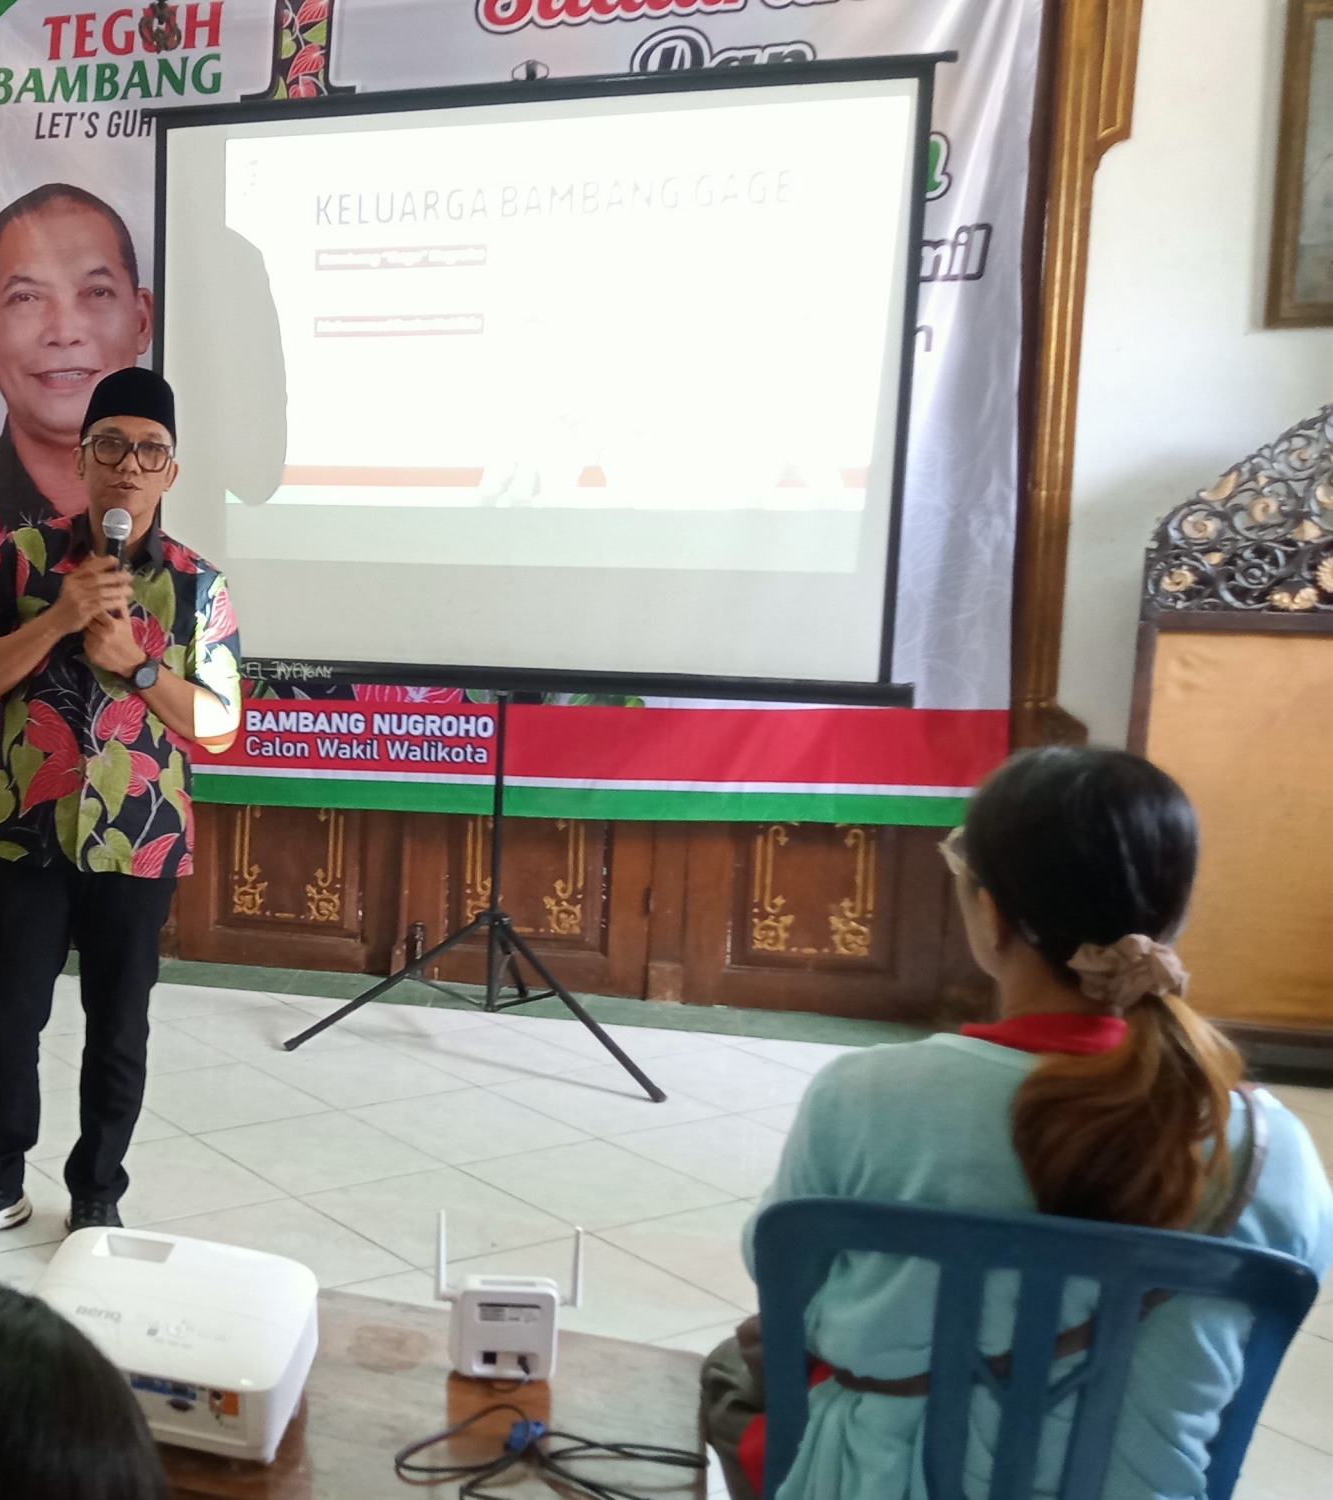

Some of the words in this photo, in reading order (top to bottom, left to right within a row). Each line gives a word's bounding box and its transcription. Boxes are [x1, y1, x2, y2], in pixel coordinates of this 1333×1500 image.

[34, 111, 100, 140] LET'S
[315, 187, 488, 227] KELUARGA
[500, 176, 679, 218] BAMBANG
[694, 169, 792, 208] GAGE
[245, 709, 366, 735] BAMBANG
[372, 713, 495, 738] NUGROHO
[245, 735, 310, 758] Calon
[316, 737, 380, 760] Wakil
[386, 739, 488, 763] Walikota
